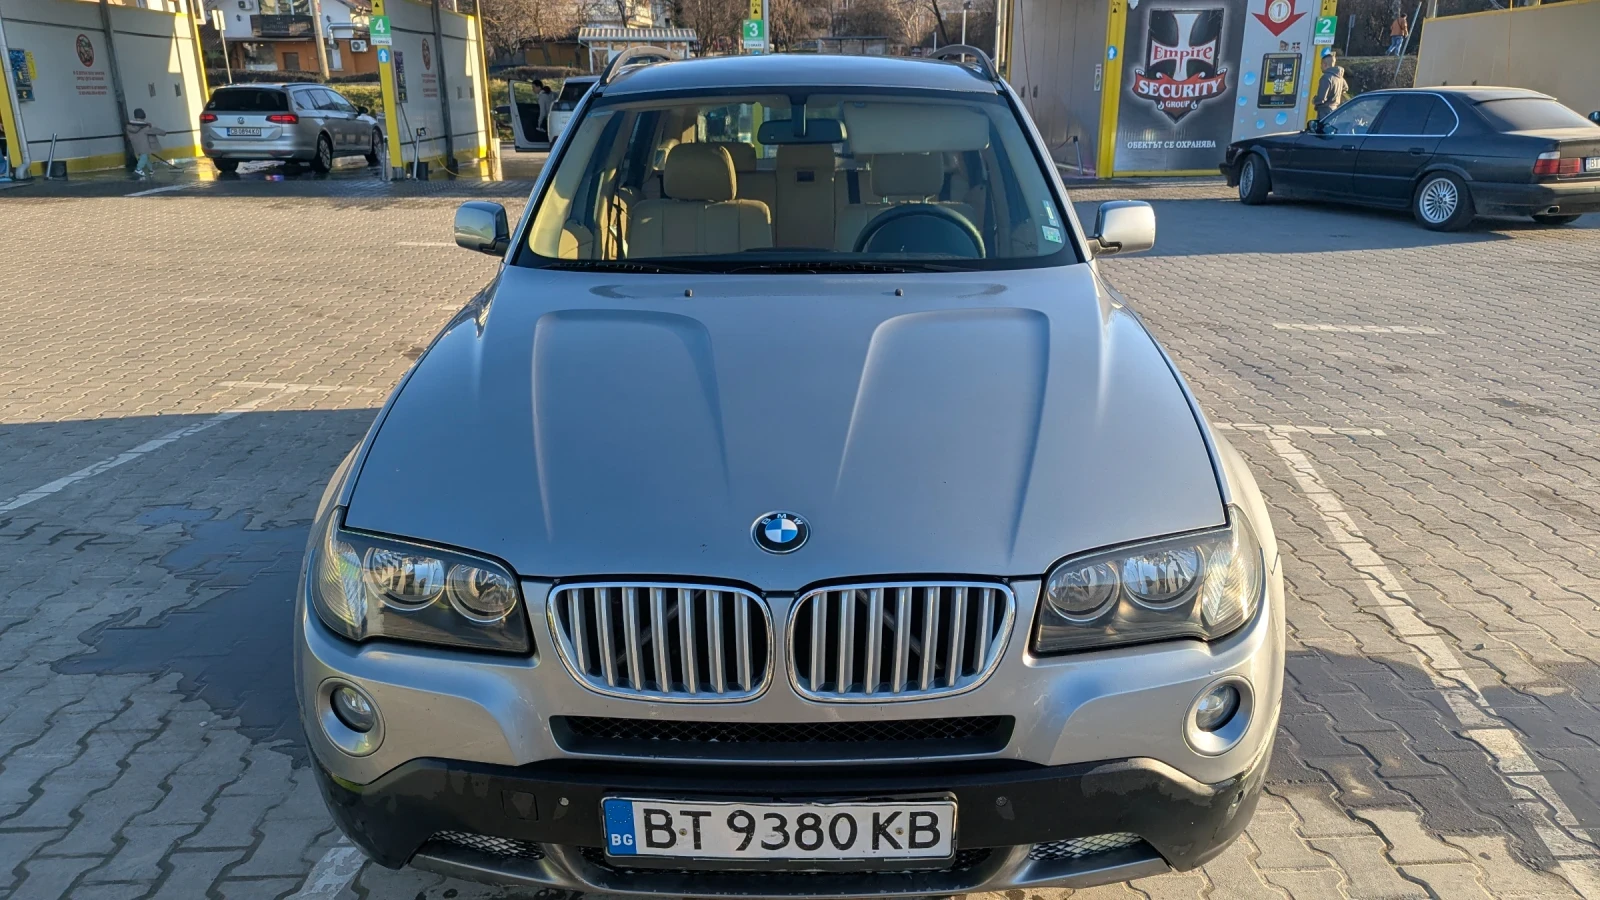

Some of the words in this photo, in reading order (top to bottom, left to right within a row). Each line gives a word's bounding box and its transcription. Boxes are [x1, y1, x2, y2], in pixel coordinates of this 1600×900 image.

[375, 18, 385, 34] 4
[749, 22, 759, 37] 3
[1321, 19, 1332, 33] 2
[1153, 45, 1213, 68] Empire
[1137, 78, 1222, 98] SECURITY
[1165, 100, 1191, 108] GROUP
[1127, 140, 1162, 149] ОБЕКТЪТ
[1164, 140, 1174, 149] СЕ
[1175, 140, 1216, 149] ОХРАНЯВА
[761, 513, 804, 526] BMW
[643, 808, 712, 850] BT
[726, 810, 858, 852] 9380
[871, 811, 941, 851] KB
[611, 833, 634, 847] BG
